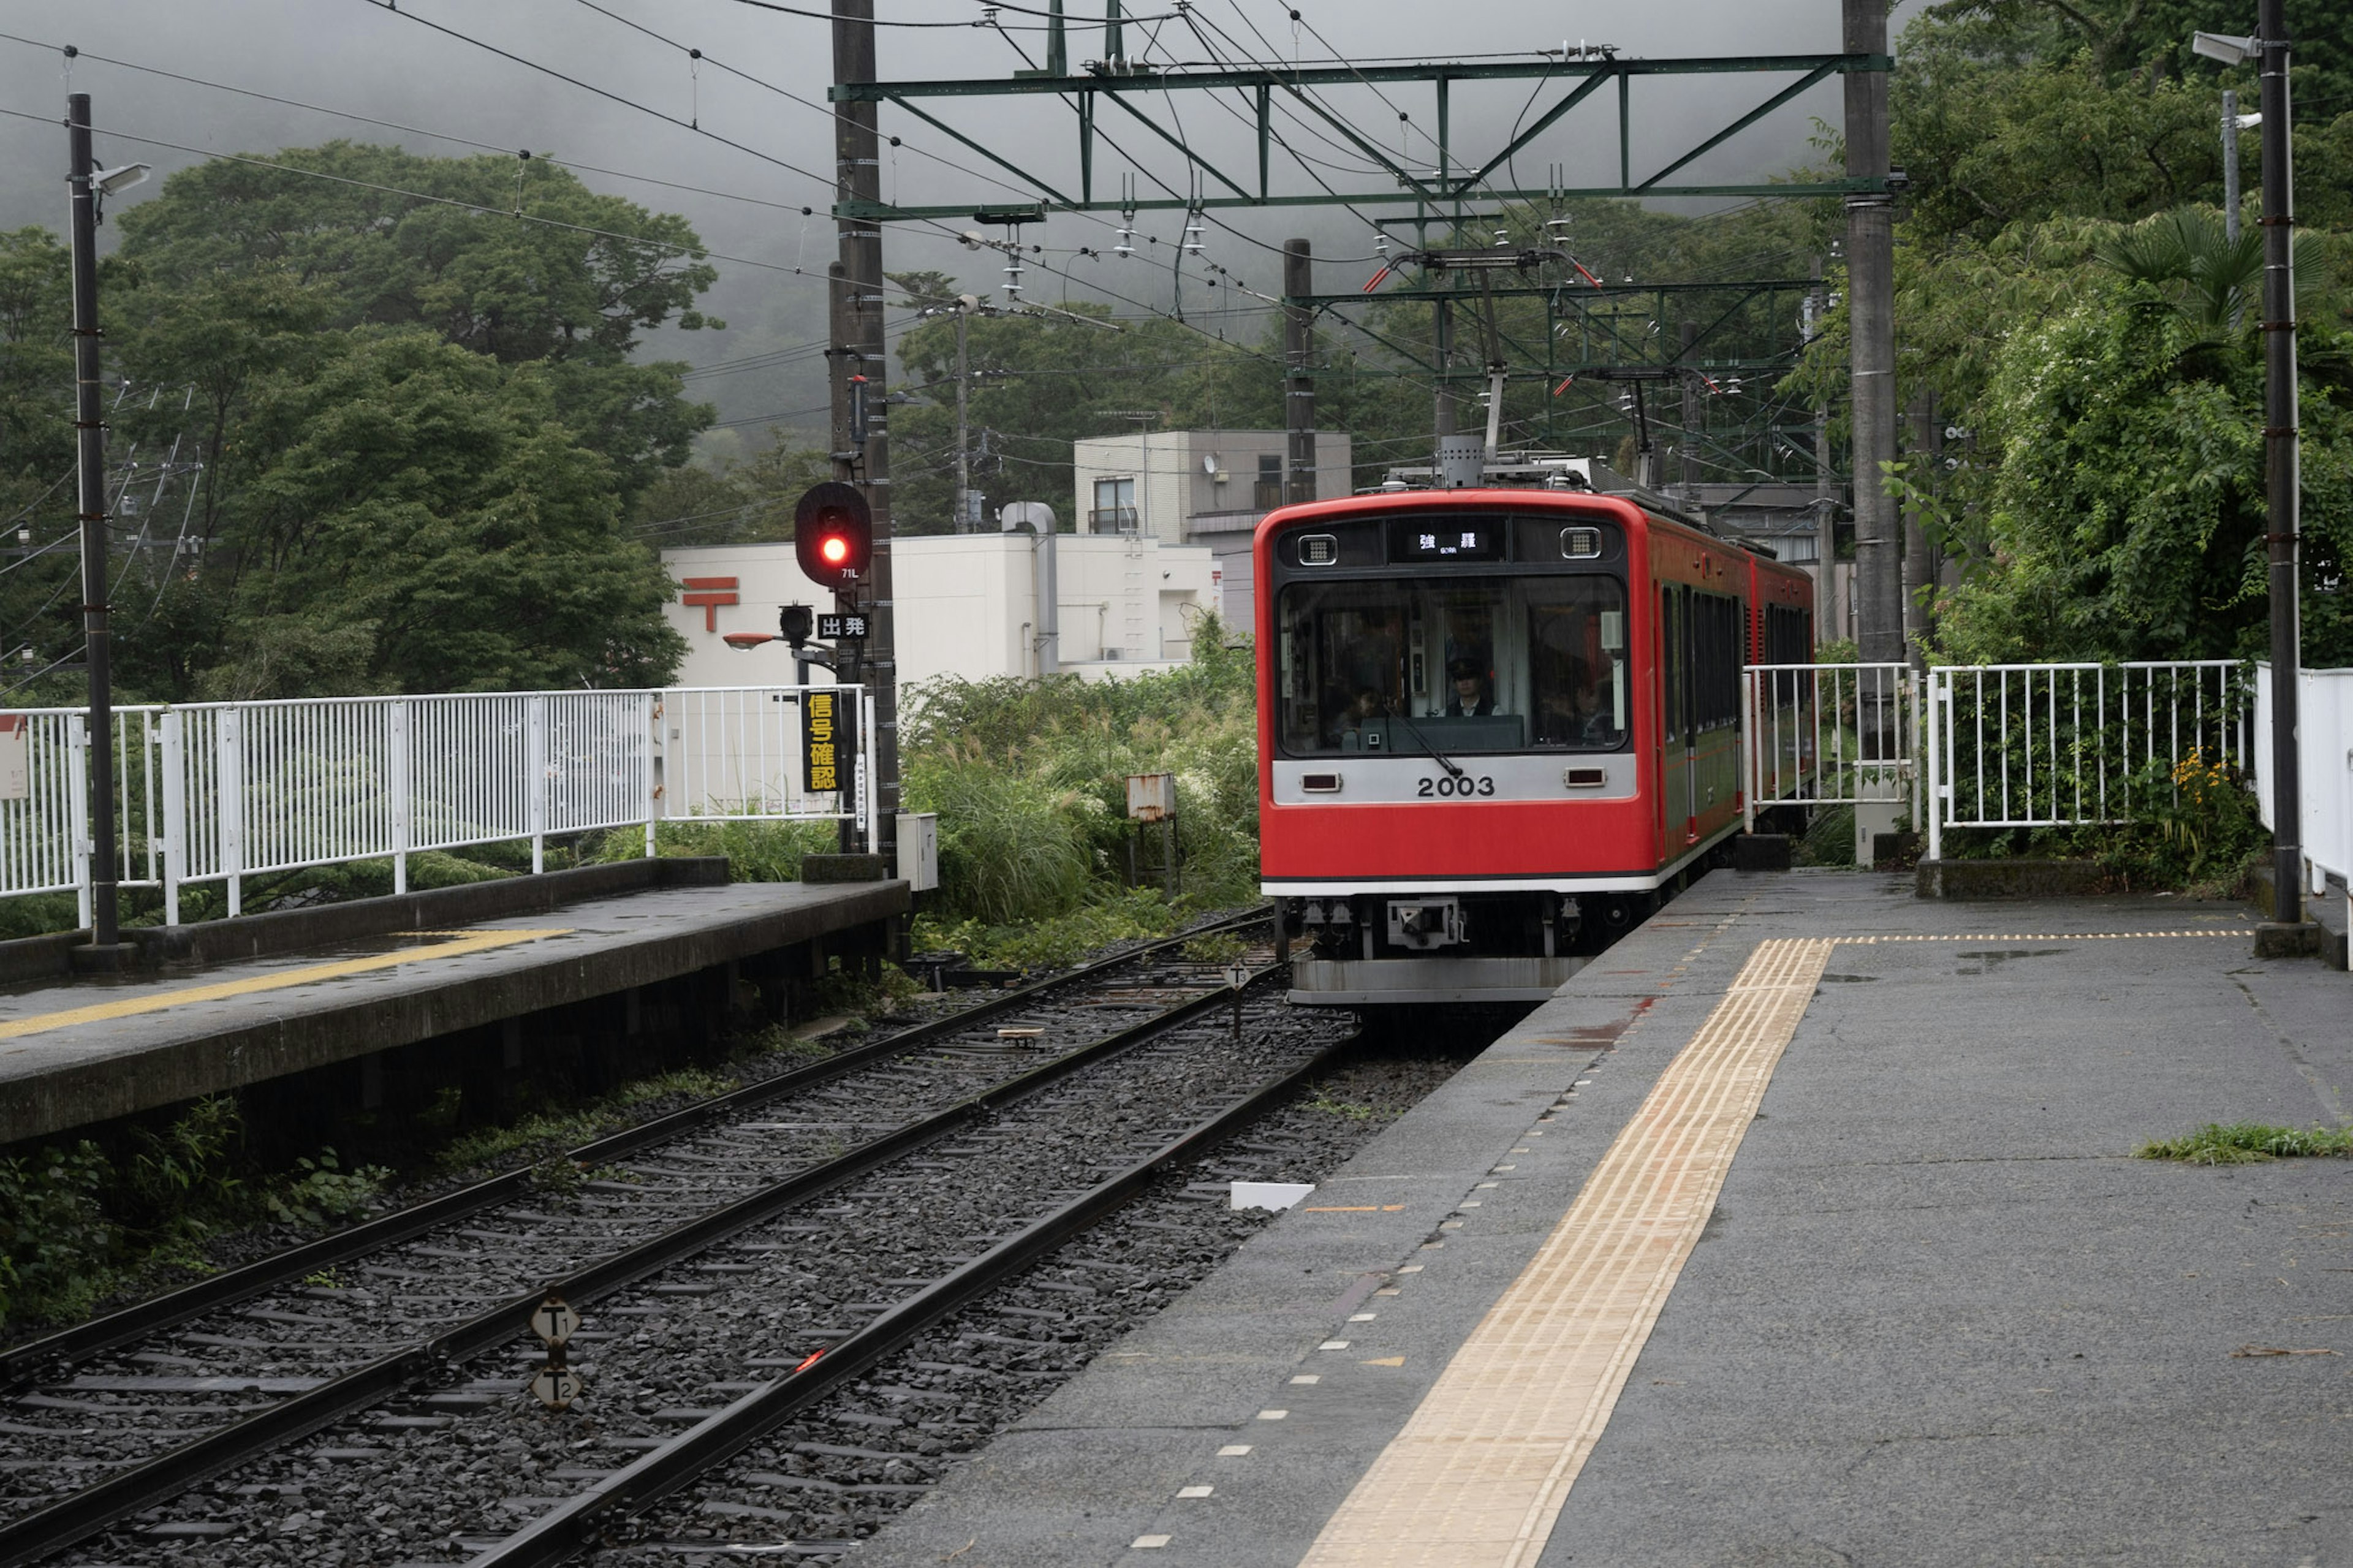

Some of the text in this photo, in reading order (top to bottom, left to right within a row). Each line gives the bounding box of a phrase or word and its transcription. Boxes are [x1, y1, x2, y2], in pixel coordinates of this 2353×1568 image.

[1419, 532, 1476, 550] 強羅
[841, 568, 859, 578] 71L
[822, 617, 865, 635] 出発
[808, 694, 836, 789] 信号確認
[1418, 776, 1495, 797] 2003
[1230, 968, 1246, 983] T3
